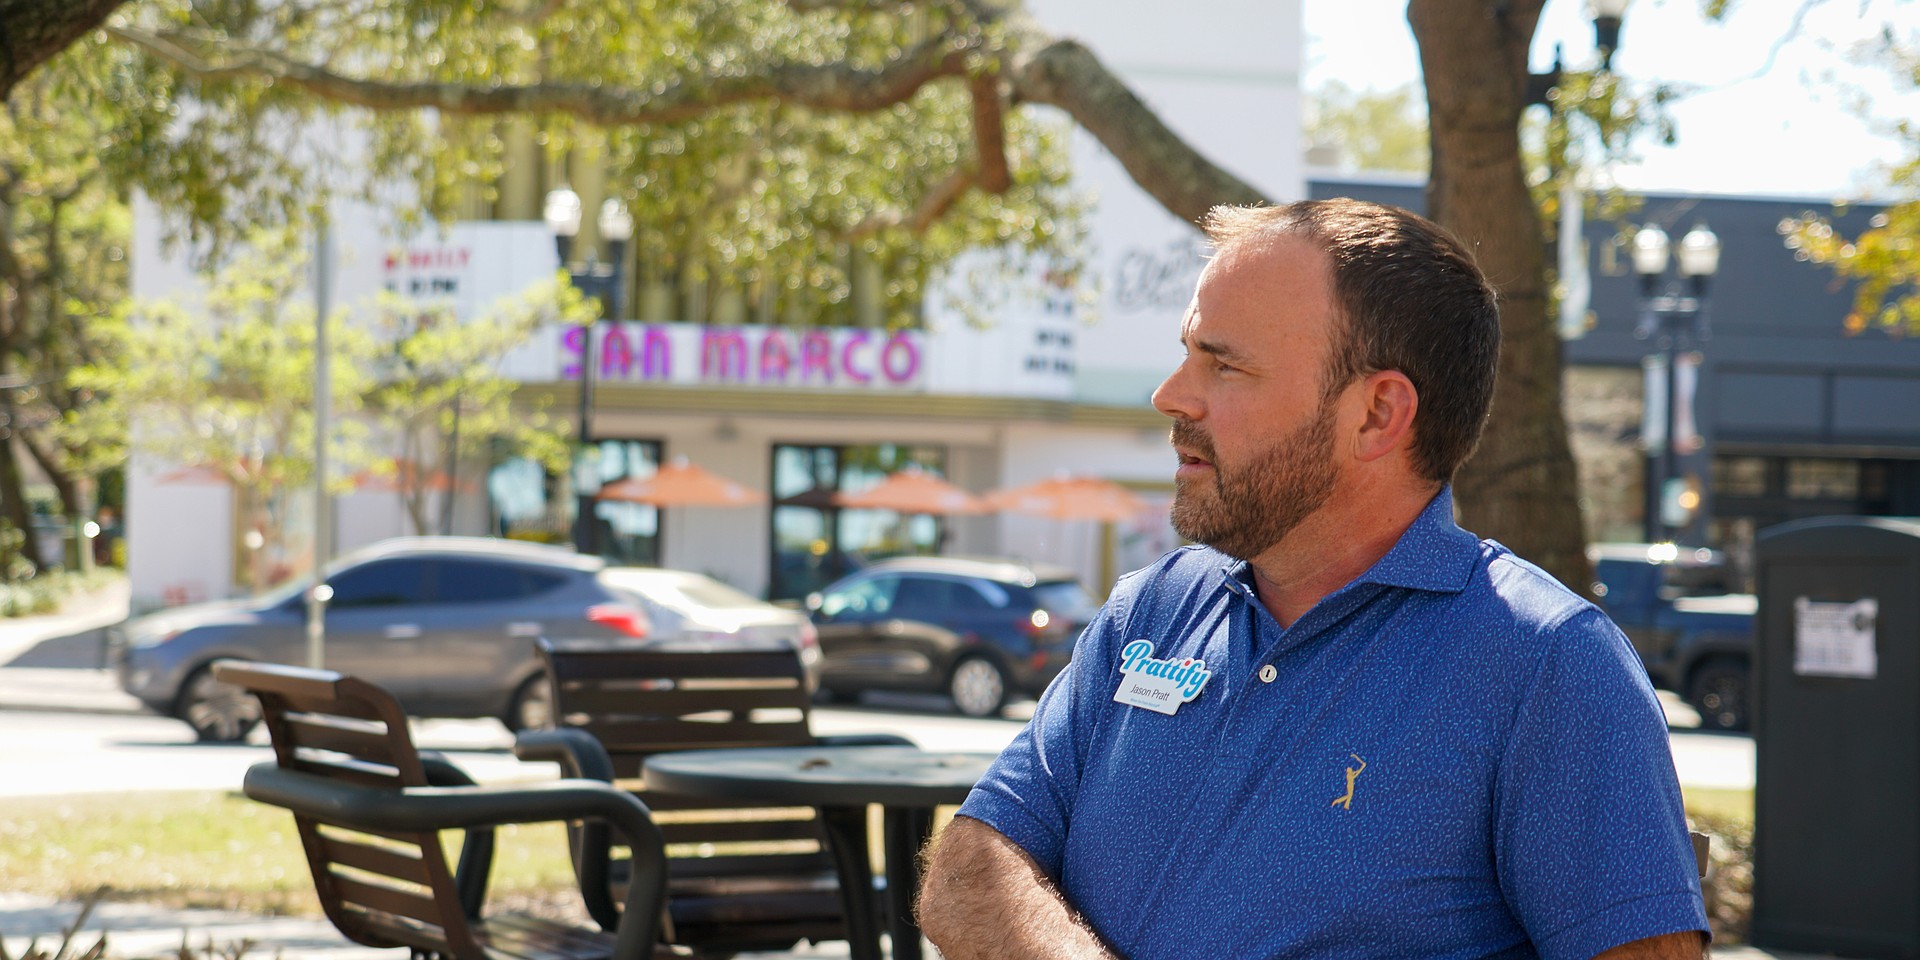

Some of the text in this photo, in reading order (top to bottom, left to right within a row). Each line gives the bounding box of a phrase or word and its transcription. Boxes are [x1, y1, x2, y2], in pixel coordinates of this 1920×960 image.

[562, 324, 921, 384] SAN MARCO
[1123, 642, 1208, 698] Prattify
[1130, 684, 1170, 702] Jason Pratt
